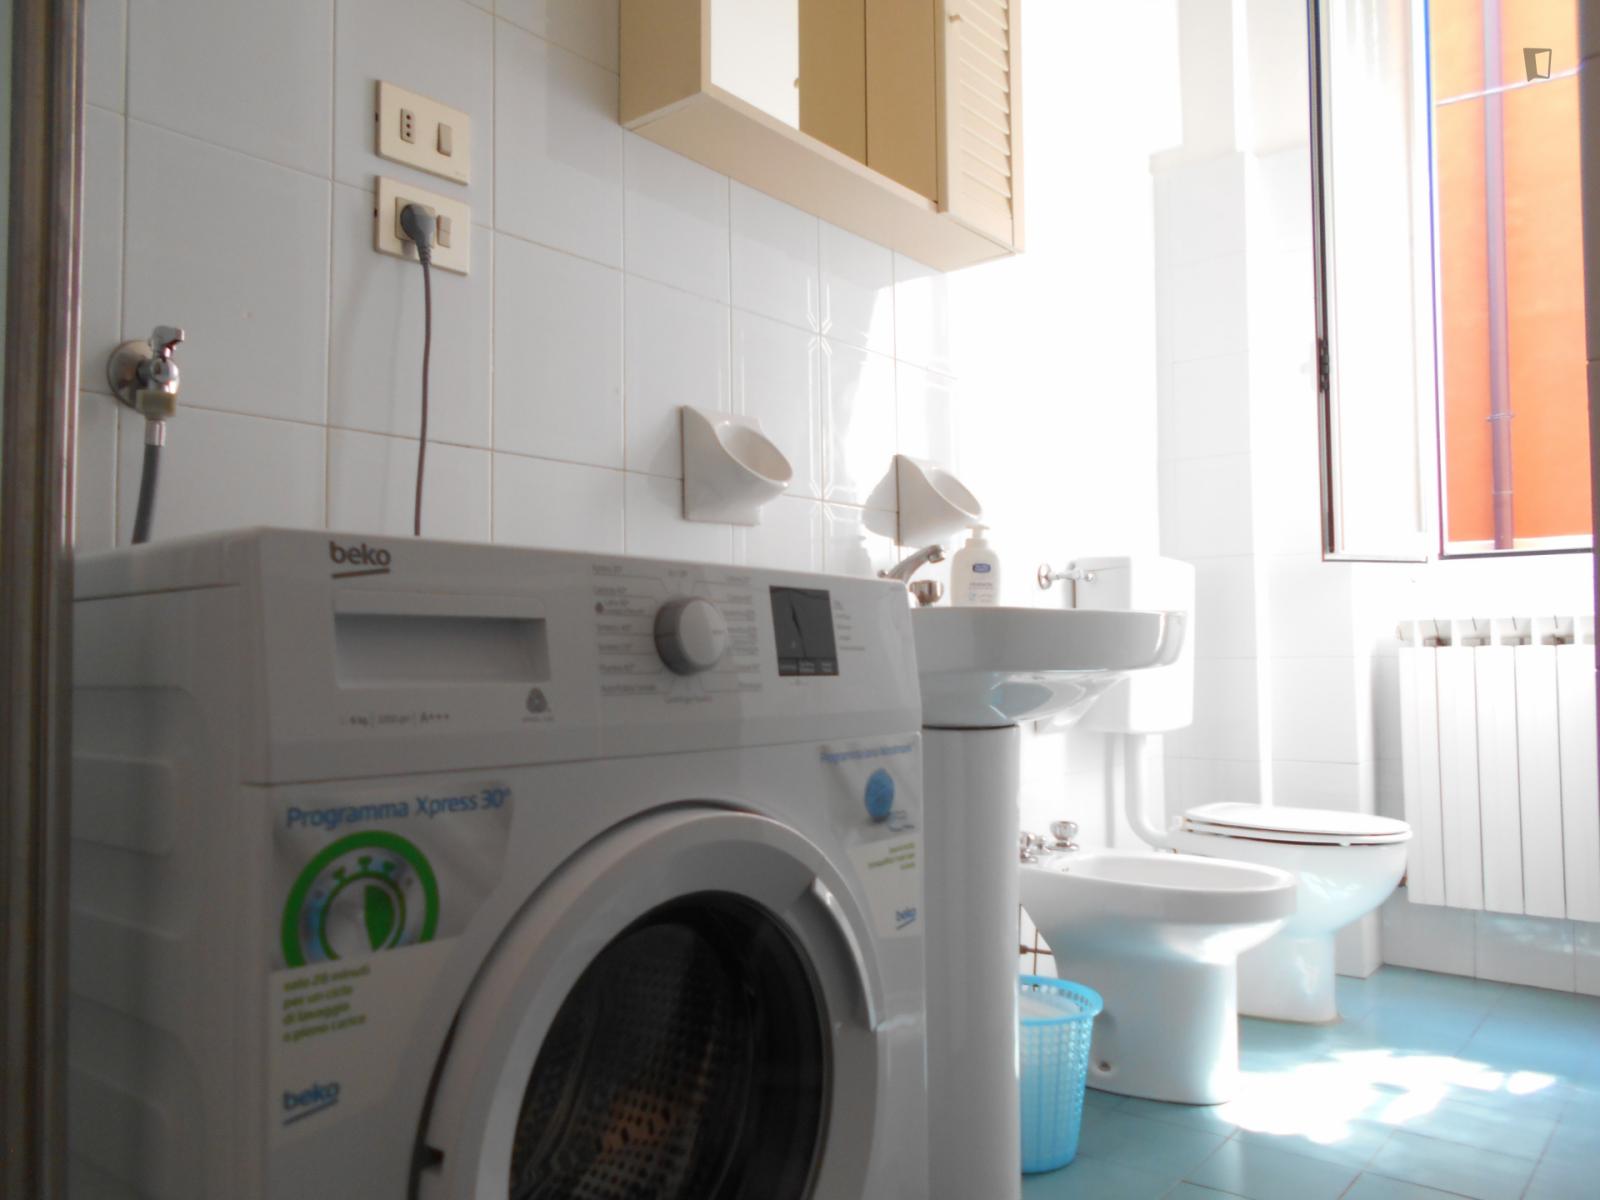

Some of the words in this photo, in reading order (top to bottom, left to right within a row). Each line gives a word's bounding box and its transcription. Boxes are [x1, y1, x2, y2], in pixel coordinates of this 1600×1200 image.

[329, 541, 391, 565] beko
[286, 800, 410, 830] Programma
[415, 795, 478, 818] Xpress
[282, 997, 305, 1010] per
[283, 1081, 340, 1111] beko
